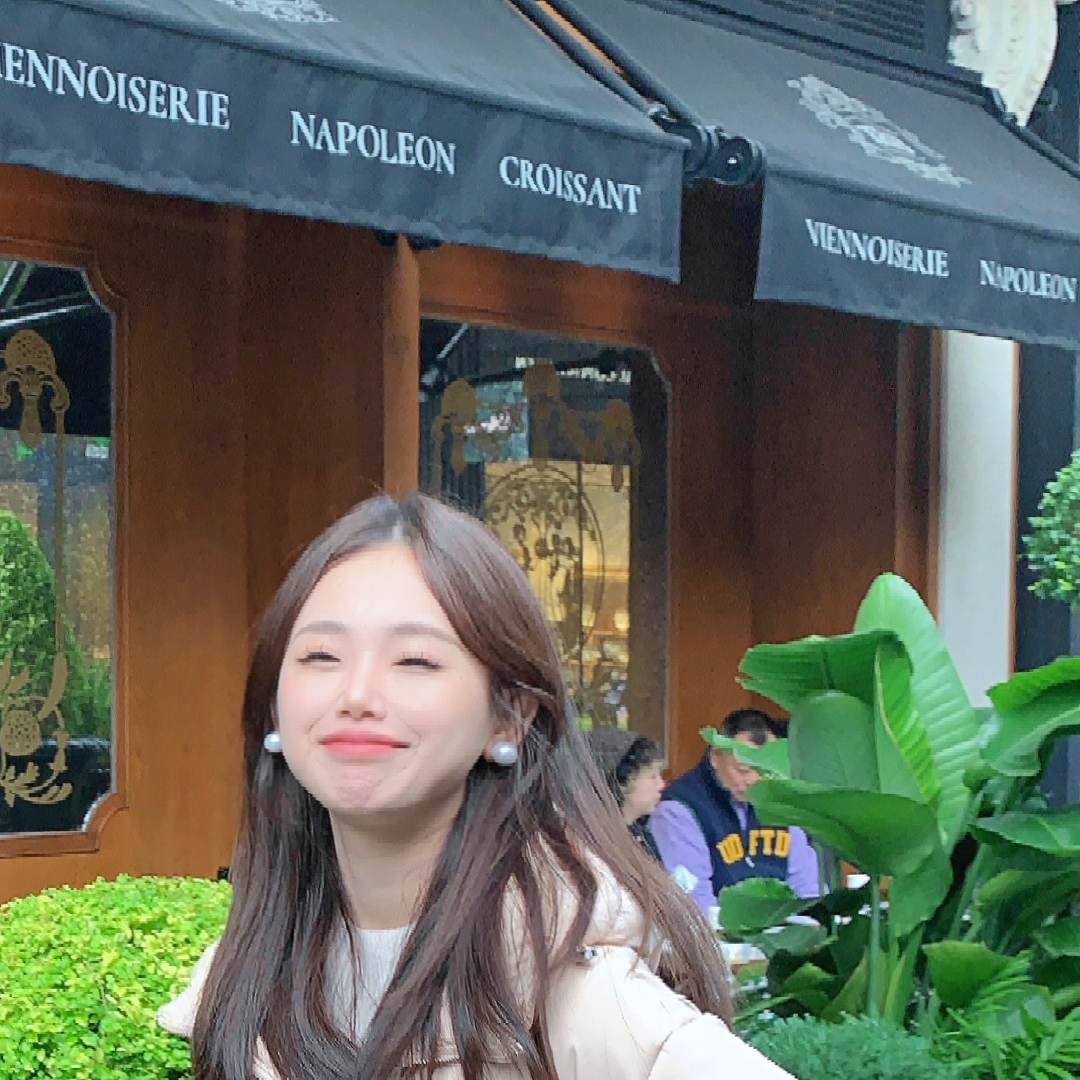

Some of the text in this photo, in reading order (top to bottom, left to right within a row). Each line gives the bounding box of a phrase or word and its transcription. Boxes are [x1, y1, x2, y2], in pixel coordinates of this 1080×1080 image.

[289, 110, 456, 176] NAPOLEON
[498, 155, 642, 215] CROISSANT
[804, 218, 1077, 302] VIENNOISERIE NAPOLEON
